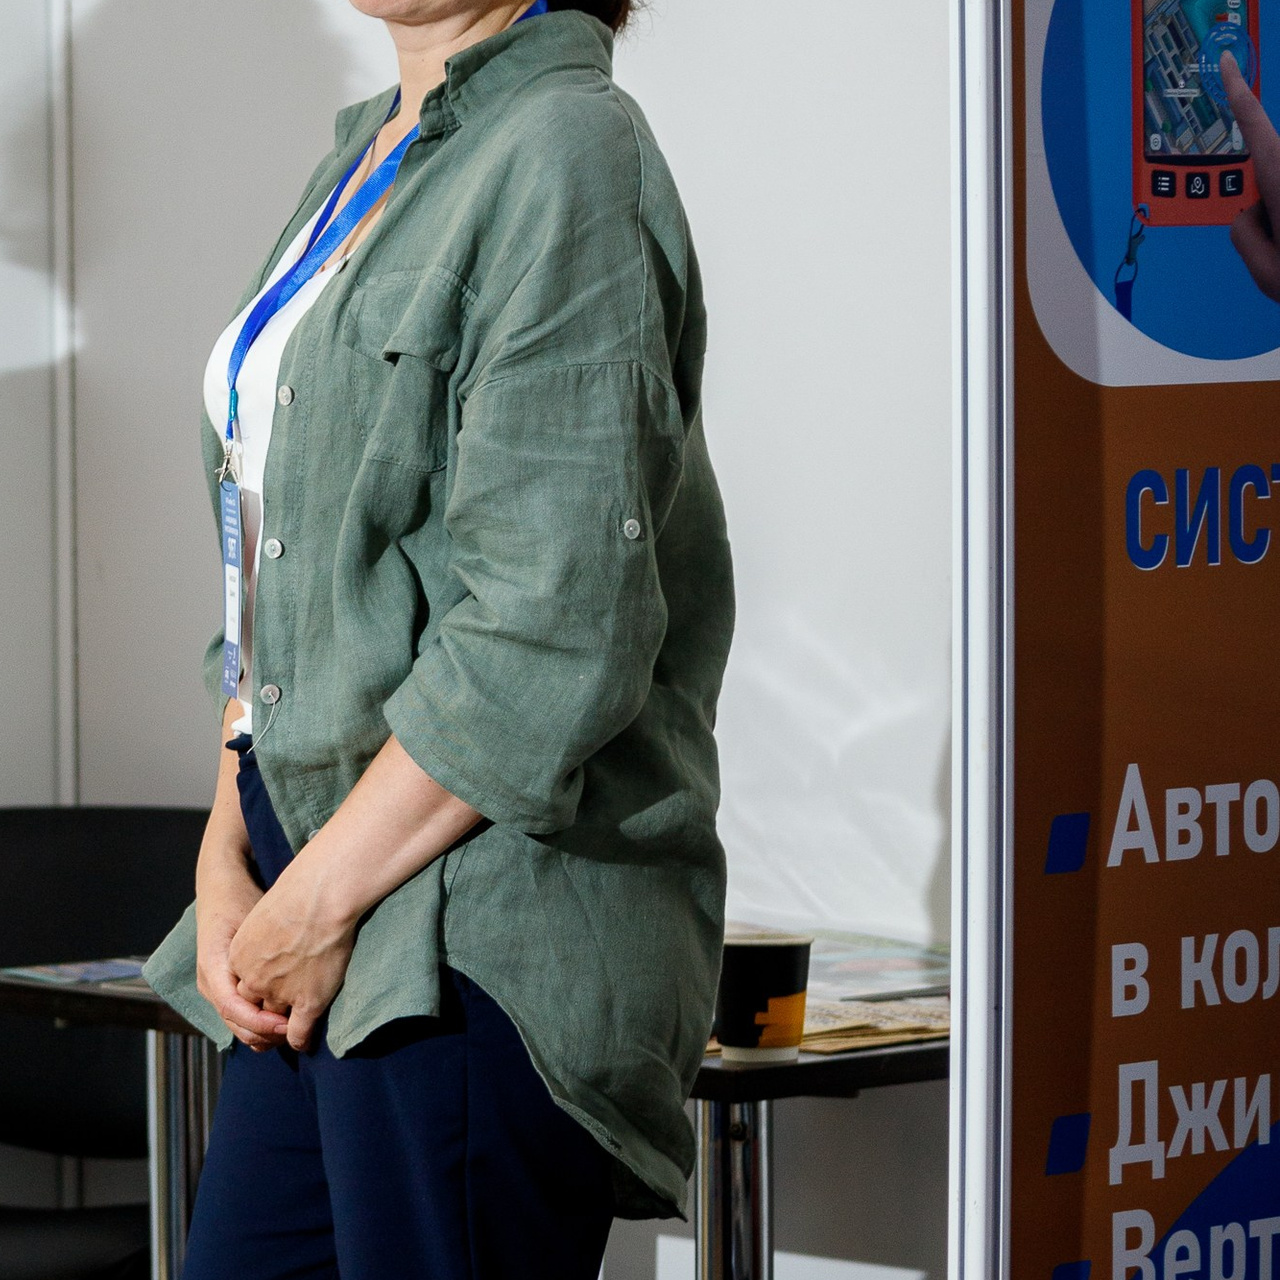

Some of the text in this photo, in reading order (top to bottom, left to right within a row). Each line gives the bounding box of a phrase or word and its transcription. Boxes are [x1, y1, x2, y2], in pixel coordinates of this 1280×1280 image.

[1125, 463, 1280, 571] СИС
[1106, 763, 1280, 868] Авто
[1109, 1060, 1271, 1186] Джи
